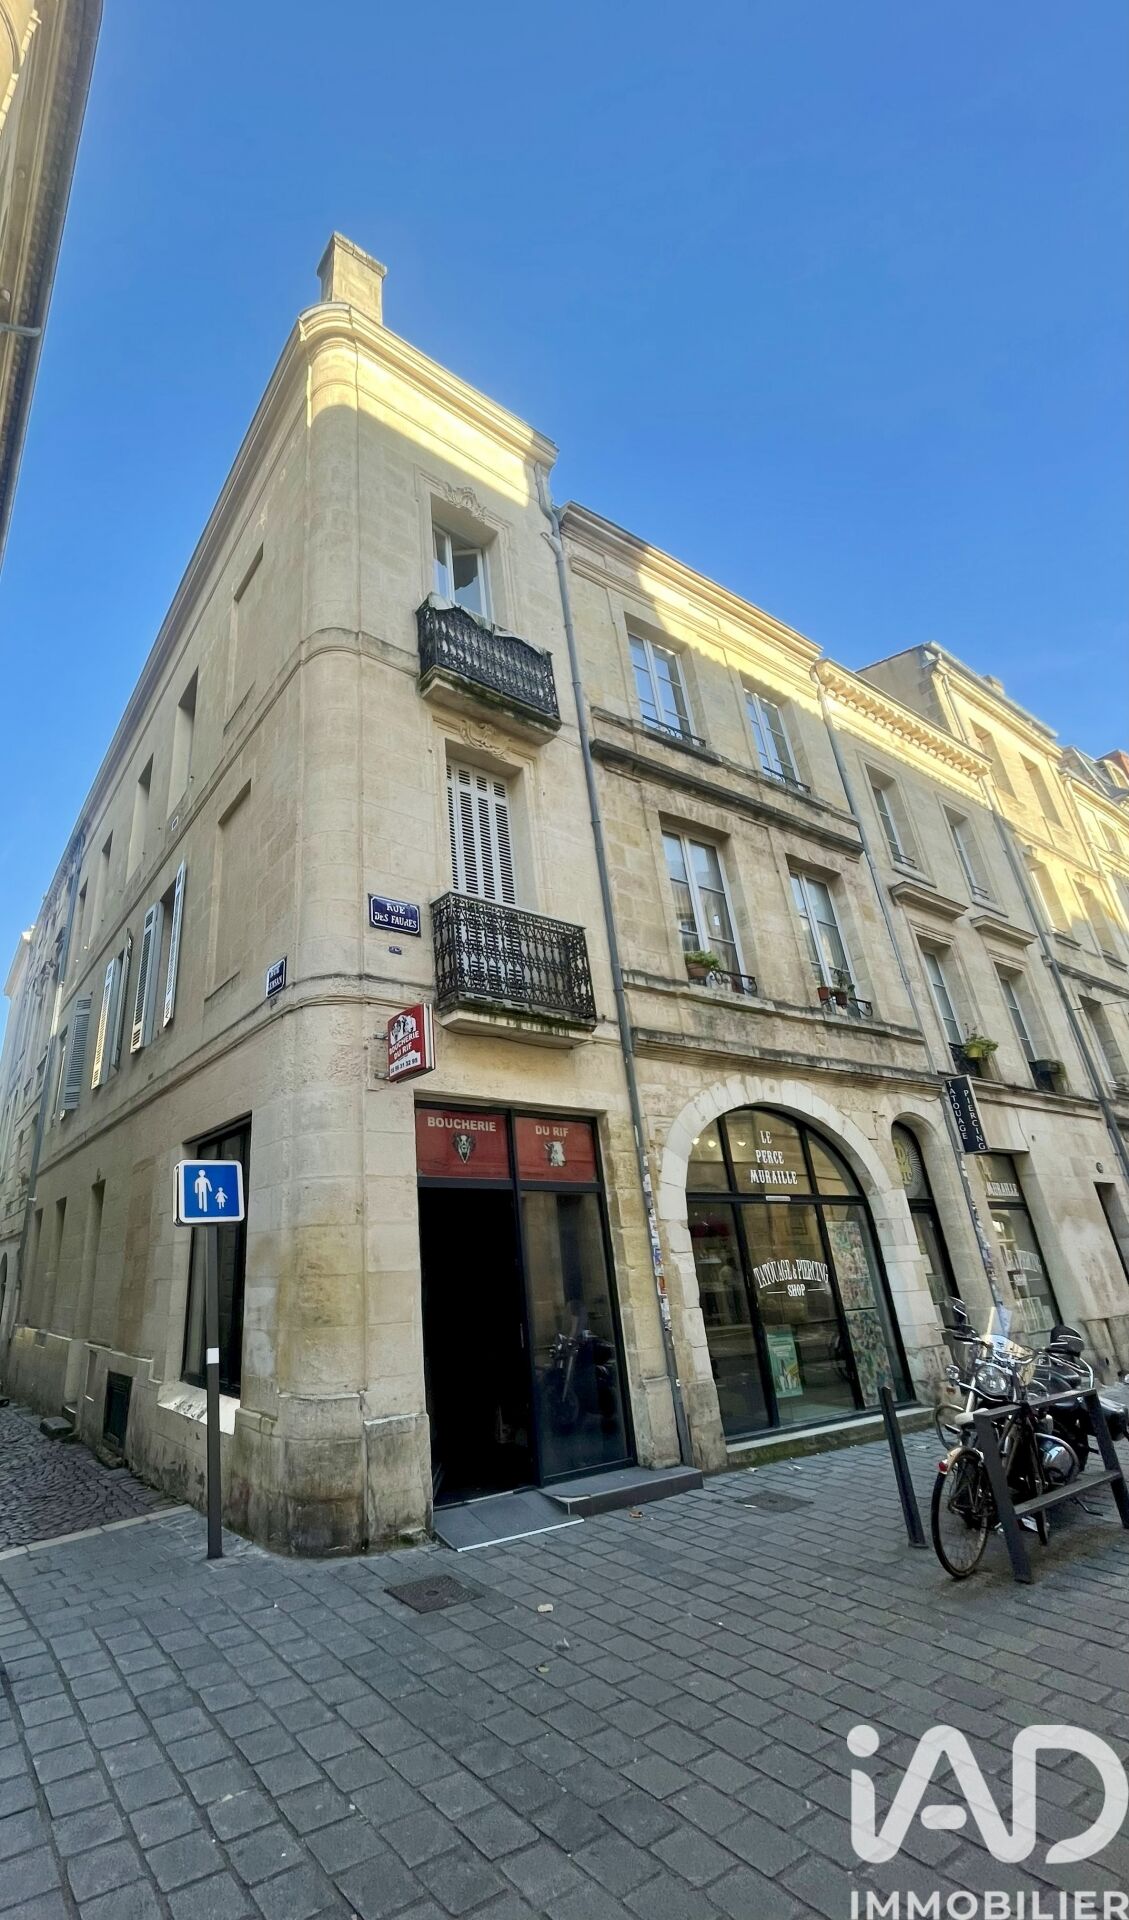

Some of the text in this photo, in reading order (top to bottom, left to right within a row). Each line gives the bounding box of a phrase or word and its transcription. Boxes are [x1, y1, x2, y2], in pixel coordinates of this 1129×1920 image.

[374, 912, 389, 922] DES
[386, 903, 406, 915] RUE
[388, 1030, 420, 1055] BOUCHERIE
[393, 1048, 402, 1060] DU
[402, 1042, 412, 1054] RIF
[947, 1079, 969, 1140] TATOUAGE
[427, 1116, 569, 1138] BOUCHERIE DU RIF
[963, 1089, 986, 1150] PIERCING
[760, 1130, 773, 1144] LE
[756, 1149, 785, 1165] PERCE
[750, 1169, 798, 1185] MURAILLE
[753, 1259, 829, 1289] TATOUAGE & PIERCING
[787, 1283, 806, 1297] SHOP
